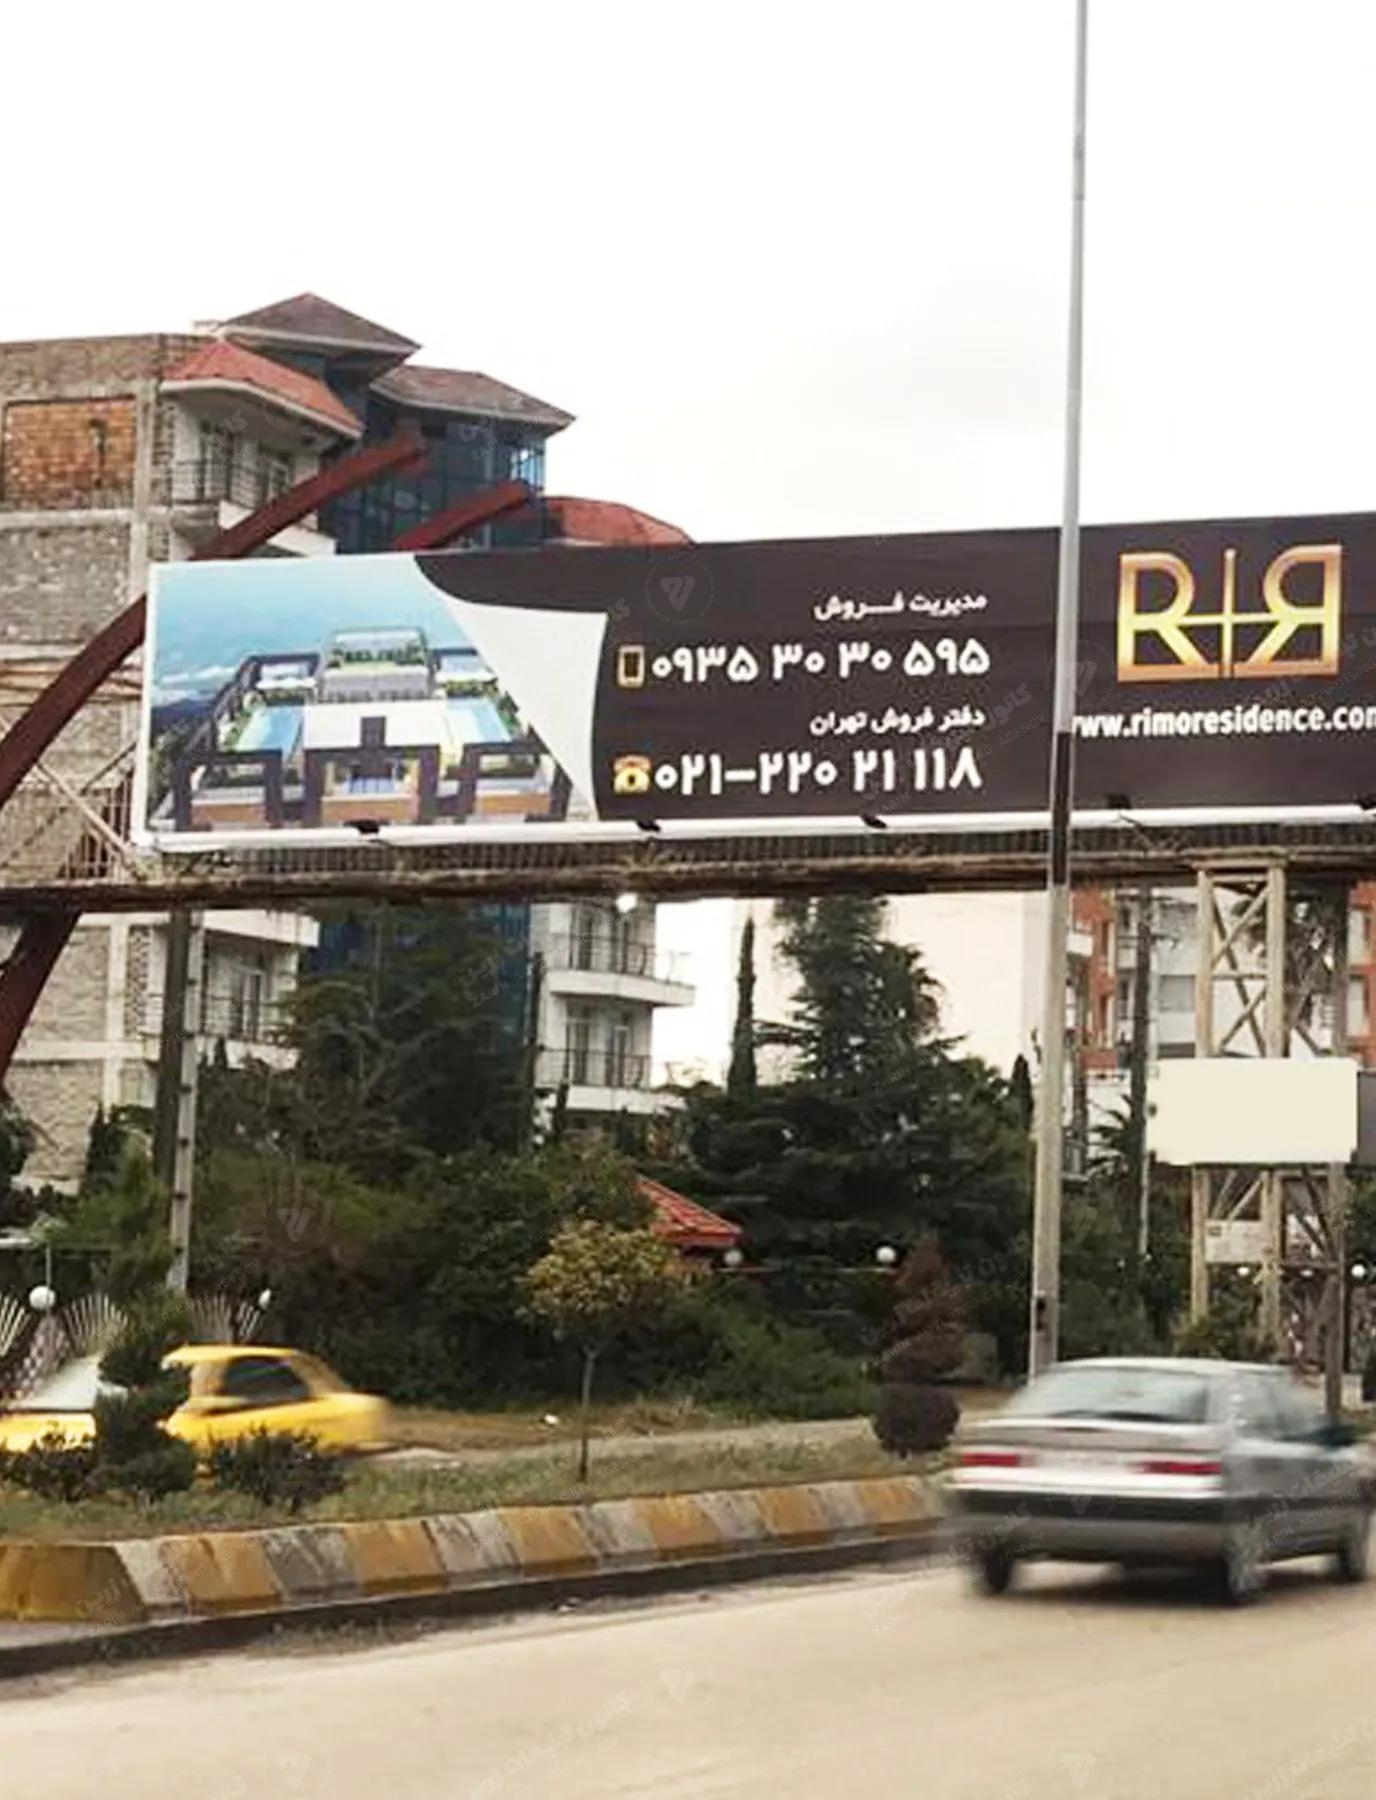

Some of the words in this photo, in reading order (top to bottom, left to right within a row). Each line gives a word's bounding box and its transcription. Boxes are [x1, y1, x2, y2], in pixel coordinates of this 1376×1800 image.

[909, 595, 987, 616] مدیریت
[652, 647, 758, 682] ۰۹۳۵
[773, 644, 825, 679] ۳۰
[839, 642, 892, 677] ۳۰
[903, 639, 990, 675] ۵۹۵
[810, 712, 867, 735] تهران
[871, 706, 933, 733] فروش
[938, 705, 985, 731] دفتر
[854, 750, 895, 791] ۲۱
[914, 747, 982, 790] ۱۱۸
